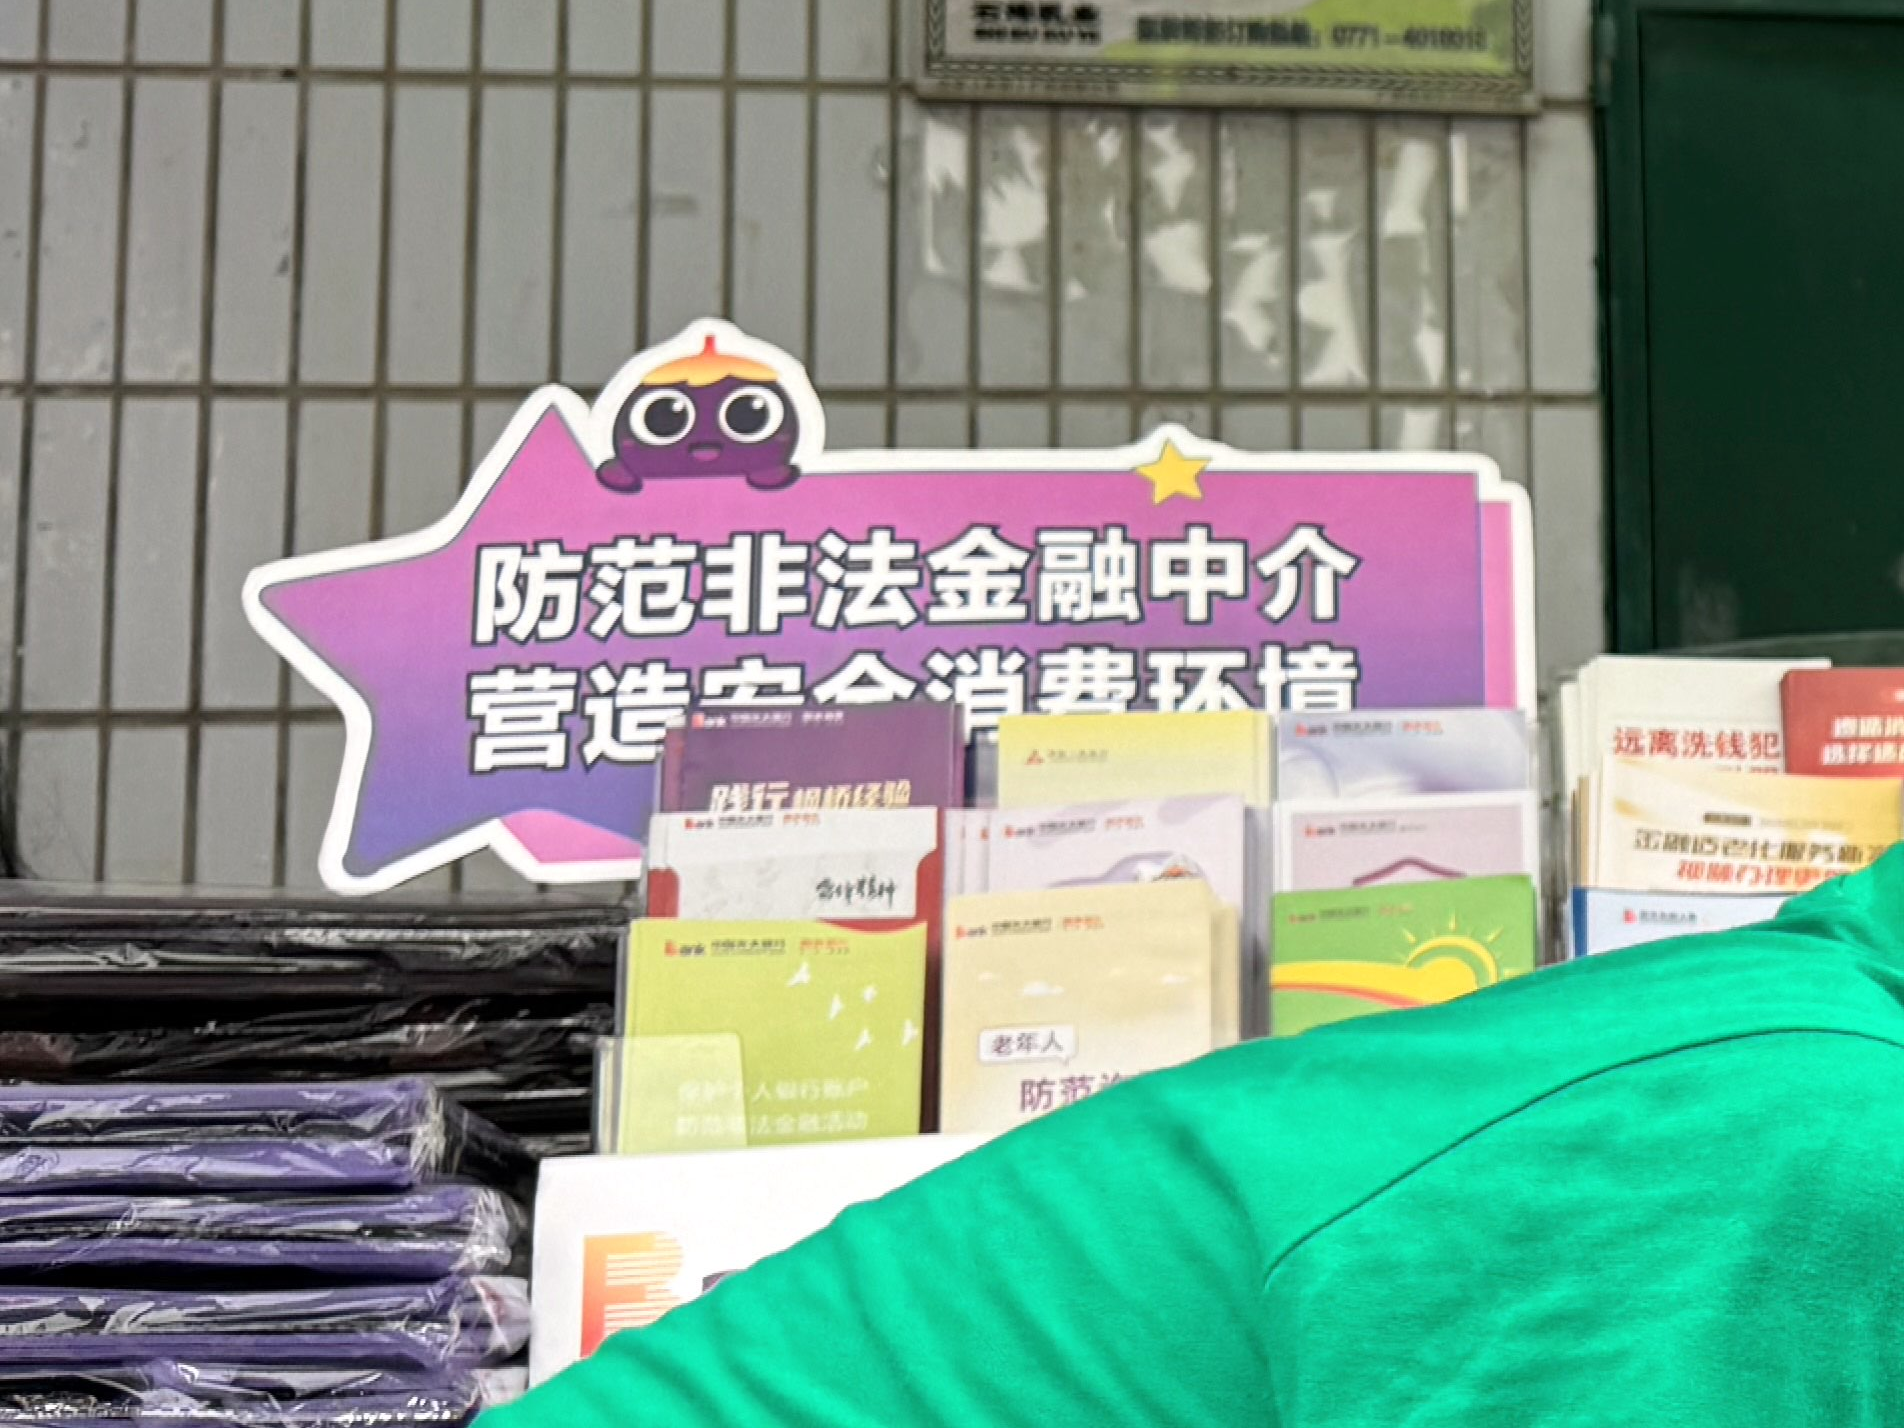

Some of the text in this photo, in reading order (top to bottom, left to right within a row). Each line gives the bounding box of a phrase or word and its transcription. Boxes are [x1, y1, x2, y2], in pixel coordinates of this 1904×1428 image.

[468, 524, 1360, 647] 防范非法金融中介
[1612, 727, 1783, 761] 远离洗钱犯
[991, 1030, 1064, 1056] 老年人
[1019, 1073, 1123, 1113] 防范
